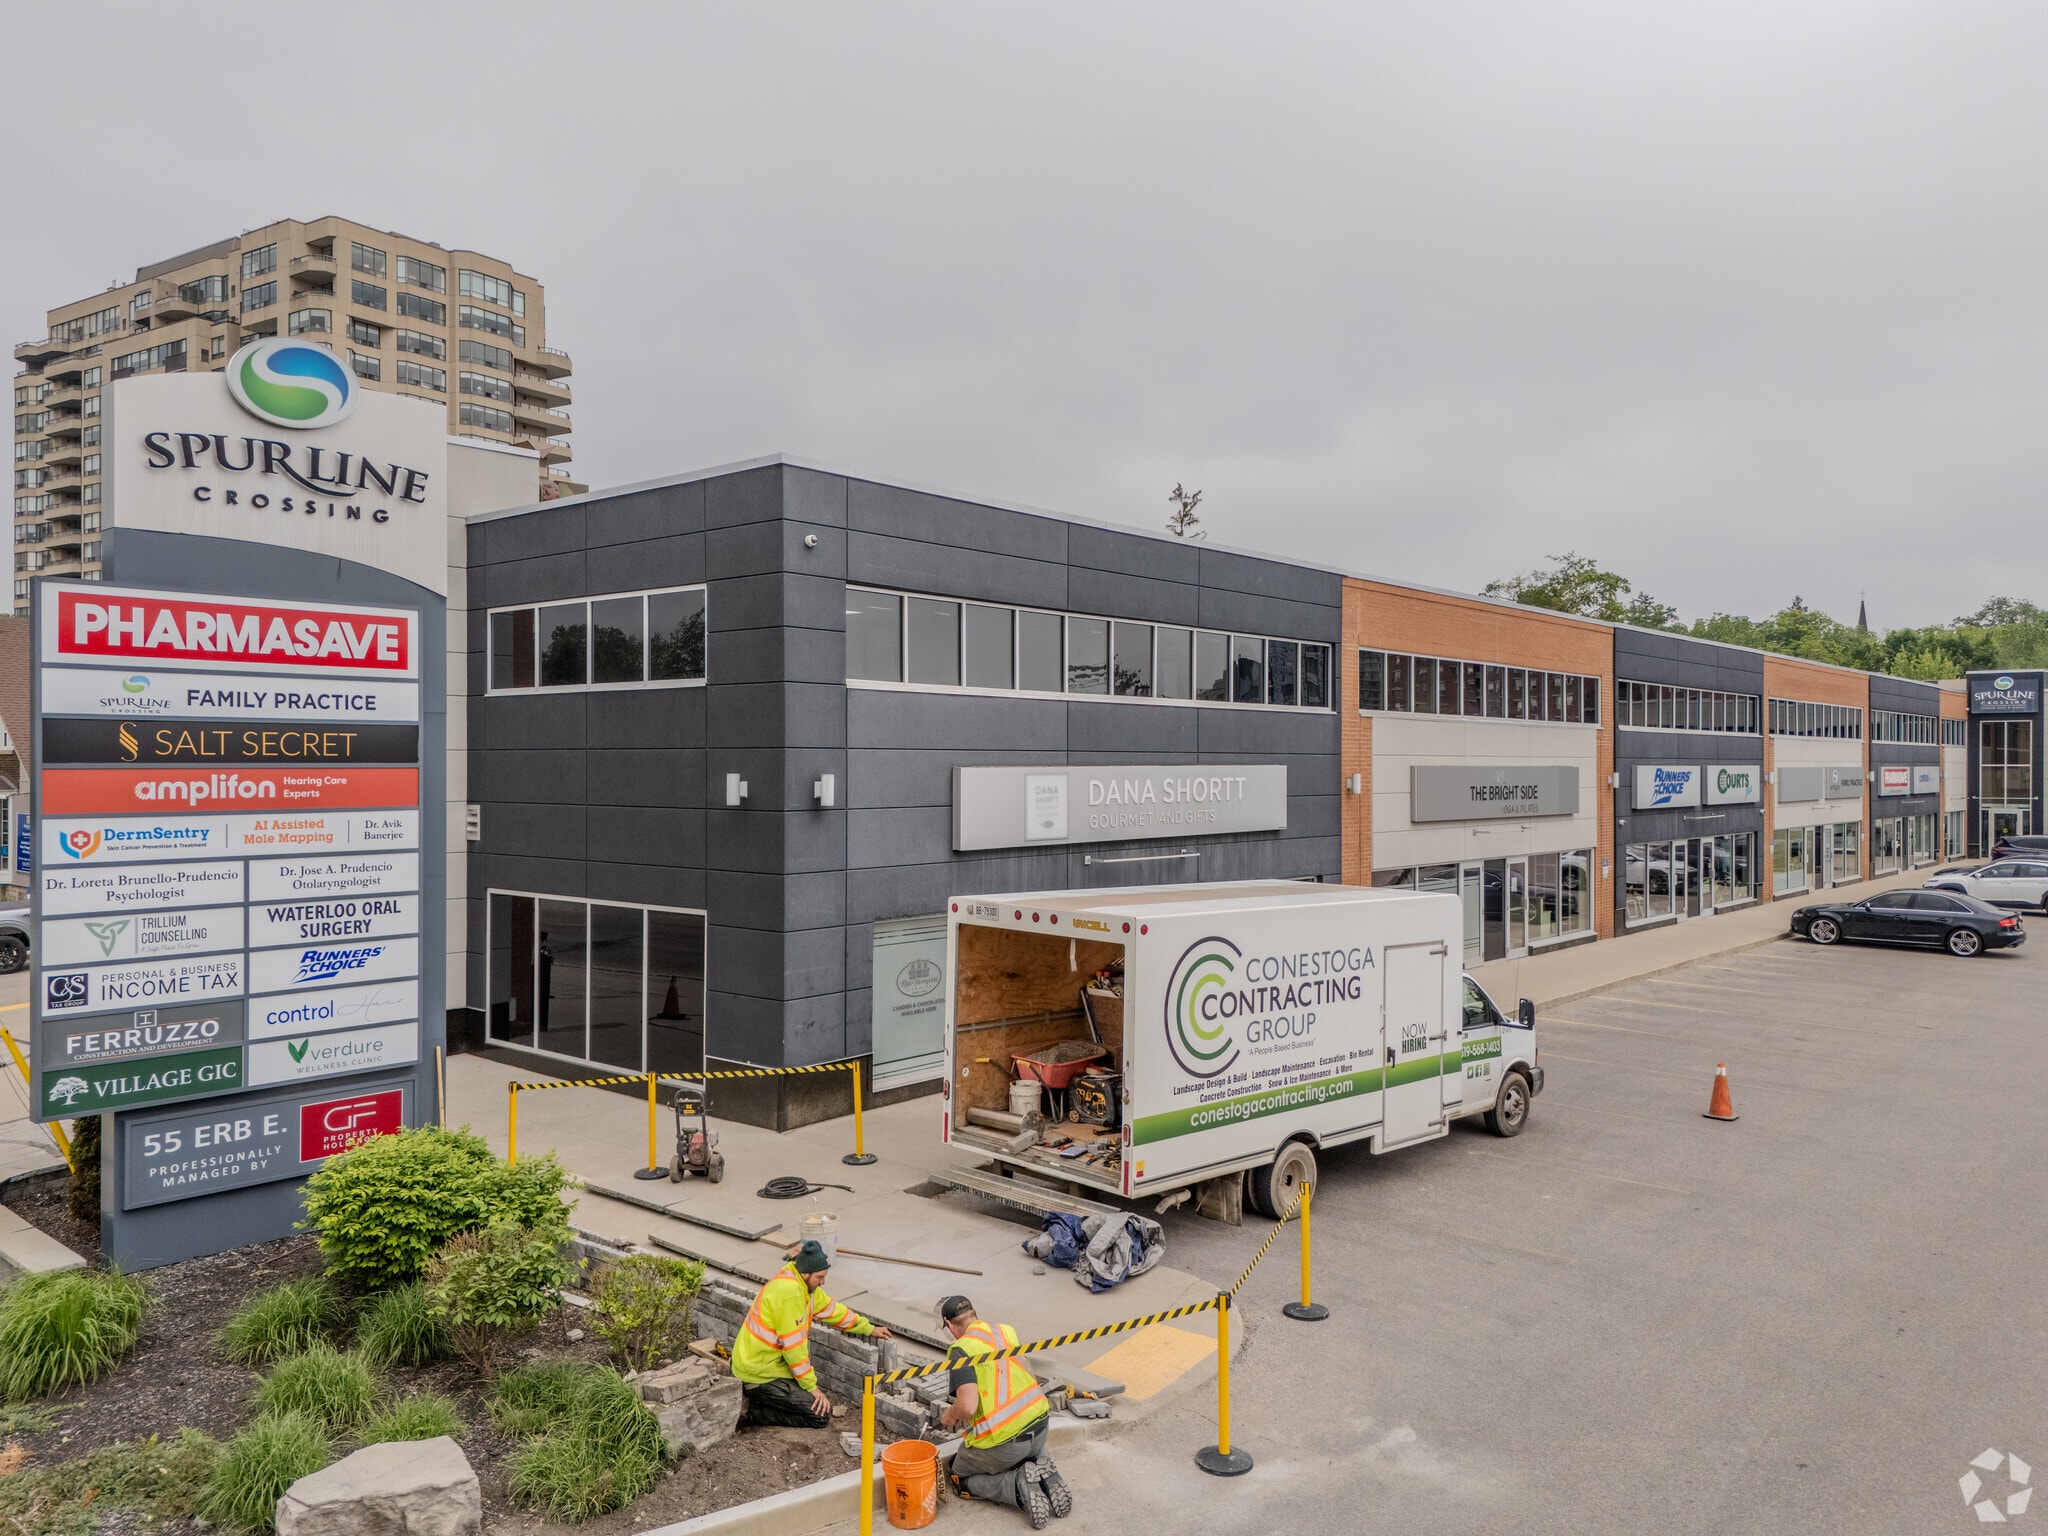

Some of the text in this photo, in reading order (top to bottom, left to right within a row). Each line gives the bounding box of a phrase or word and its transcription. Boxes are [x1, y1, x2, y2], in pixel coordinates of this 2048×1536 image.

[144, 432, 430, 504] SPURLINE
[193, 486, 391, 523] CROSSING
[74, 603, 399, 661] PHARMASAVE
[100, 697, 171, 709] SPURLINE
[187, 689, 377, 711] FAMILY PRACTICE
[1974, 690, 2035, 701] SPURLINE
[155, 729, 357, 757] SALT SECRET
[135, 774, 275, 806] amplifon
[283, 776, 347, 787] Hearing Care
[1088, 776, 1247, 806] DANA SHORTT
[1658, 783, 1684, 794] CHOICE
[1717, 768, 1749, 794] COURTS
[283, 789, 320, 799] Experts
[1470, 785, 1538, 801] THE BRIGHT SIDE
[254, 819, 324, 831] AI Assisted
[365, 819, 402, 829] Dr. Avik
[1089, 809, 1216, 829] GOURMET AND GIFTS
[104, 827, 209, 841] DermSentry
[244, 832, 334, 846] Mole Mapping
[364, 831, 404, 841] Banerjee
[46, 870, 238, 890] Dr. Loreta Brunello-Prudencio
[279, 862, 393, 878] Dr. Jose A. Prudencio
[292, 877, 381, 890] Otolaryngologist
[106, 887, 185, 903] Psychologist
[267, 900, 401, 922] WATERLOO ORAL
[141, 915, 186, 929] TRILLIUM
[300, 919, 372, 938] SURGERY
[141, 928, 208, 944] COUNSELLING
[300, 946, 386, 963] RUNNERS'
[1246, 946, 1375, 983] CONESTOGA
[102, 970, 165, 983] PERSONAL
[181, 962, 236, 976] BUSINESS
[309, 958, 368, 972] CHOICE
[102, 972, 238, 1000] INCOME TAX
[1201, 976, 1361, 1021] CONTRACTING
[266, 1000, 334, 1025] control
[66, 1020, 219, 1054] FERRUZZO
[1246, 1012, 1316, 1043] GROUP
[1402, 1022, 1427, 1039] NOW
[74, 1048, 138, 1060] CONSTRUCTION
[157, 1038, 214, 1050] DEVELOPMENT
[311, 1040, 383, 1060] verdure
[1254, 1046, 1273, 1056] People
[1274, 1043, 1291, 1051] Based
[1402, 1036, 1427, 1053] HIRING
[296, 1056, 383, 1074] WELLNESS CLINIC
[1173, 1048, 1374, 1096] Landscape Design & Build Landscape Maintenance Excavation Bin Rental
[93, 1062, 237, 1097] VILLAGE GIC
[1199, 1064, 1353, 1103] Concrete Construction Snow & Ice Maintenance & More
[1190, 1079, 1353, 1127] conestogacontracting.com
[144, 1114, 287, 1157] 55 ERB E.
[323, 1128, 378, 1143] PROPERTY
[150, 1145, 282, 1177] PROFESSIONALLY
[163, 1159, 268, 1188] MANAGED BY
